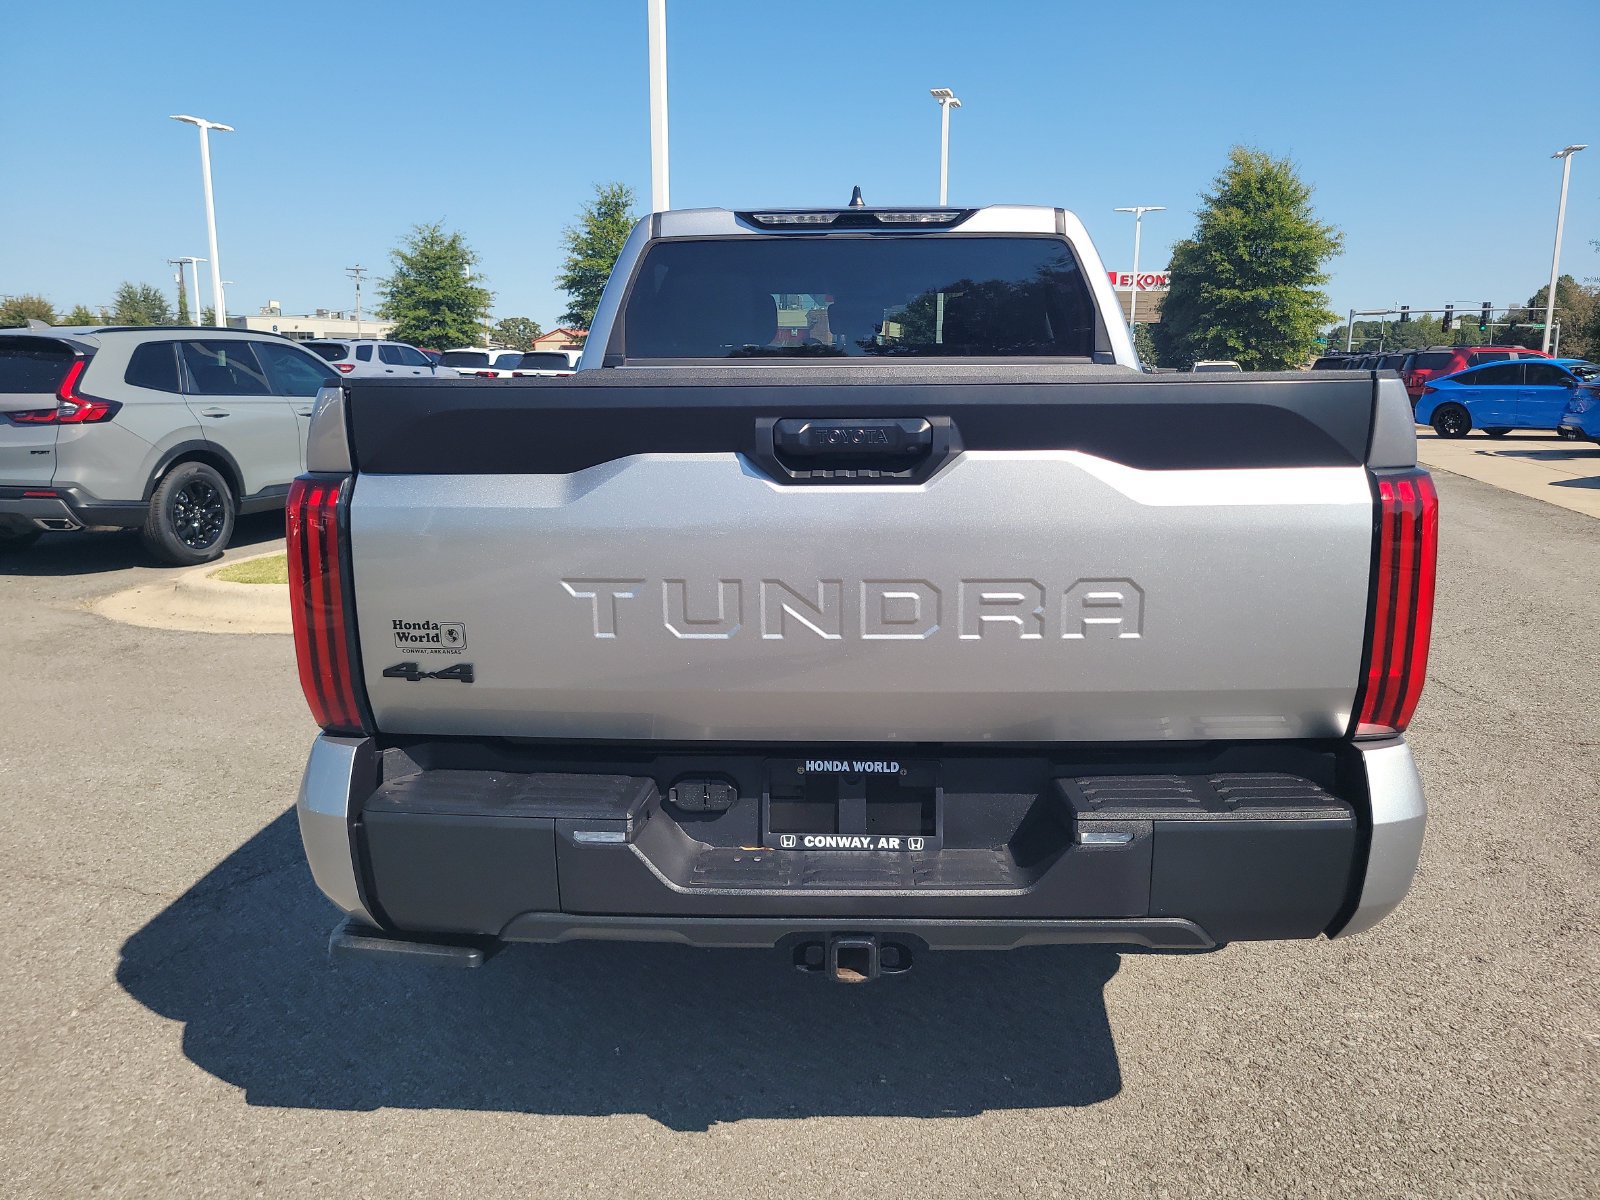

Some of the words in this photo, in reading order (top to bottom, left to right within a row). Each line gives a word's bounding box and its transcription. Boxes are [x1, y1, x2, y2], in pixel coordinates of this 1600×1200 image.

[816, 429, 889, 444] TOYOTA
[560, 578, 1145, 640] TUNDRA
[392, 619, 439, 630] Honda
[396, 631, 440, 643] World
[805, 760, 850, 772] HONDA
[853, 761, 900, 773] WORLD
[804, 836, 874, 850] CONWAY,
[878, 838, 900, 849] AR
